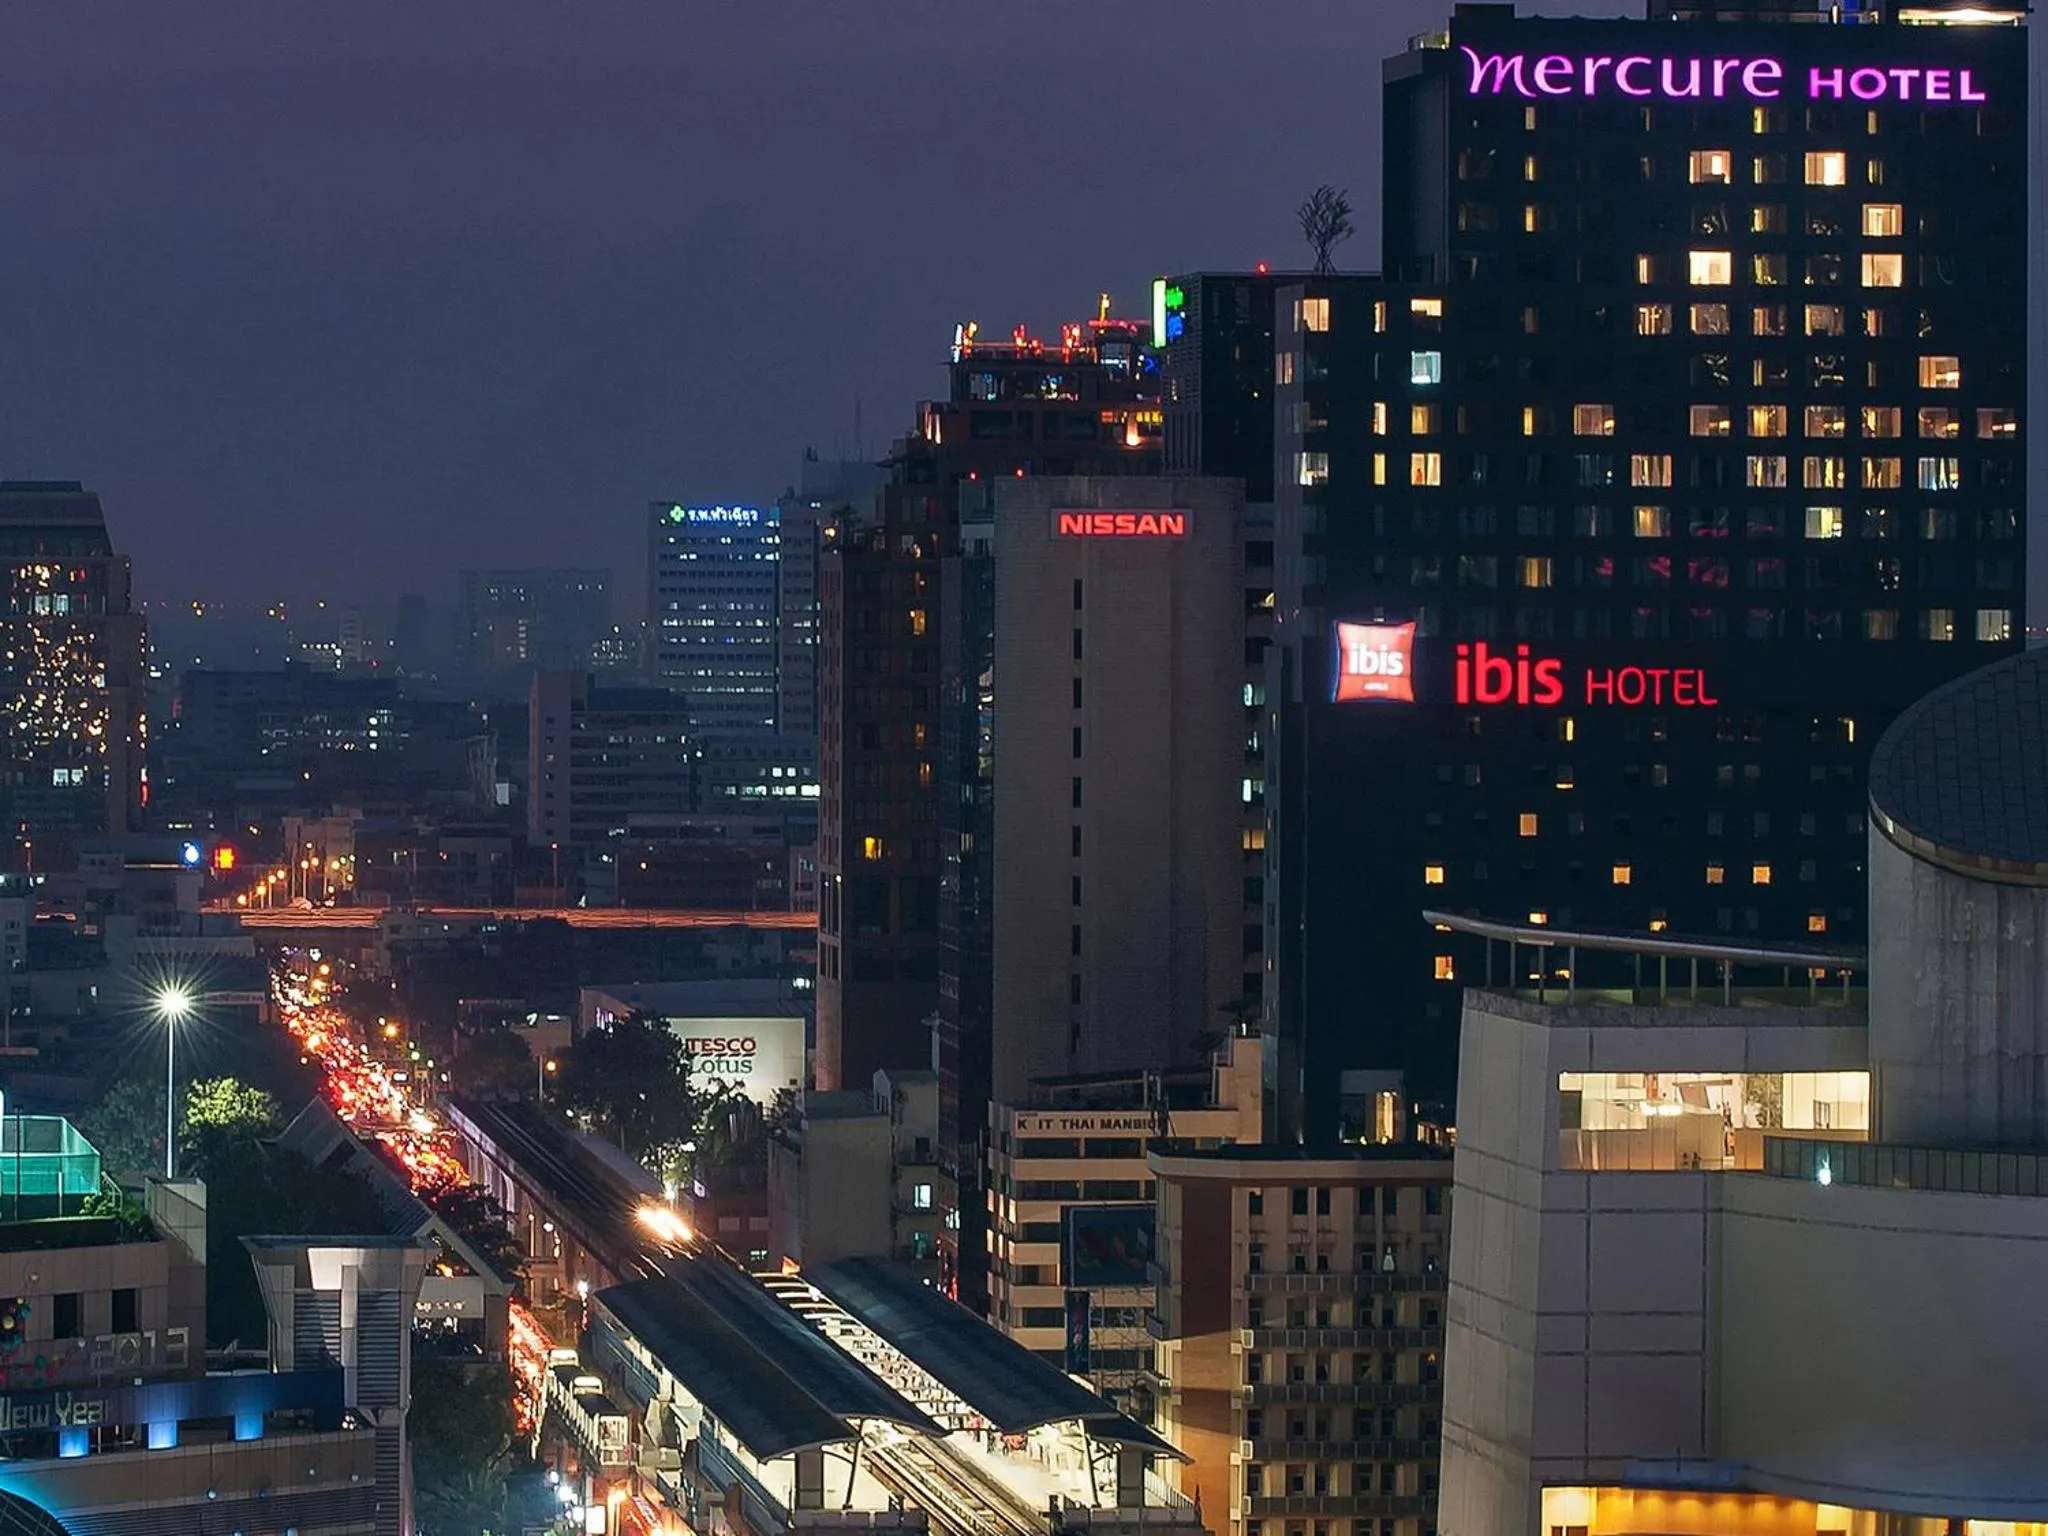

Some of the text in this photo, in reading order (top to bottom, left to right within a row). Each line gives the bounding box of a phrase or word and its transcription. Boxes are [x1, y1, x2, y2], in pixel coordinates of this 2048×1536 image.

[1461, 46, 1986, 101] mercure HOTEL
[1060, 514, 1183, 535] NISSAN
[1348, 642, 1404, 676] ibis
[1455, 642, 1719, 706] ibis HOTEL
[685, 1037, 756, 1053] TESCO
[1060, 1118, 1094, 1130] THAI
[90, 1327, 189, 1374] 2013
